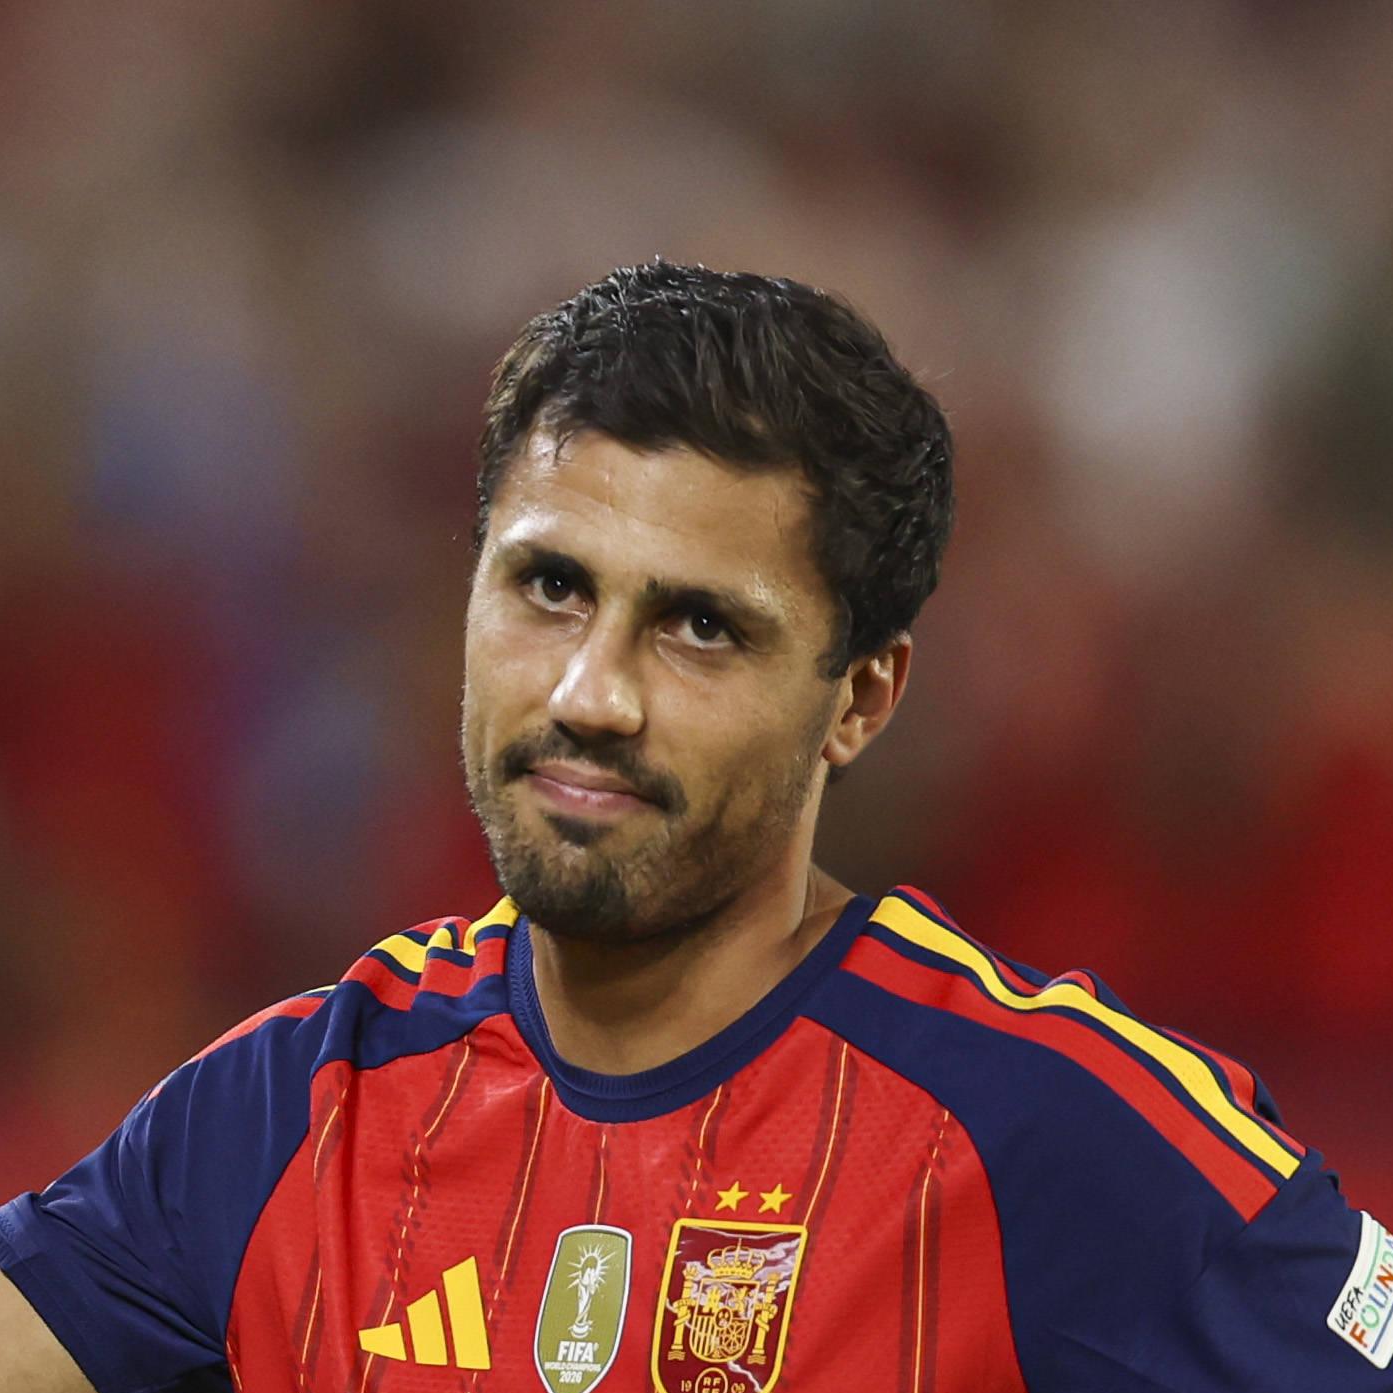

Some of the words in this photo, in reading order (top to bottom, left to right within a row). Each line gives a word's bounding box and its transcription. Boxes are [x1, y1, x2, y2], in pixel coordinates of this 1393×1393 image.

[1335, 1286, 1364, 1330] UEFA
[558, 1340, 594, 1362] FIFA
[559, 1371, 583, 1384] 2026
[703, 1377, 721, 1386] RF
[681, 1380, 692, 1392] 19
